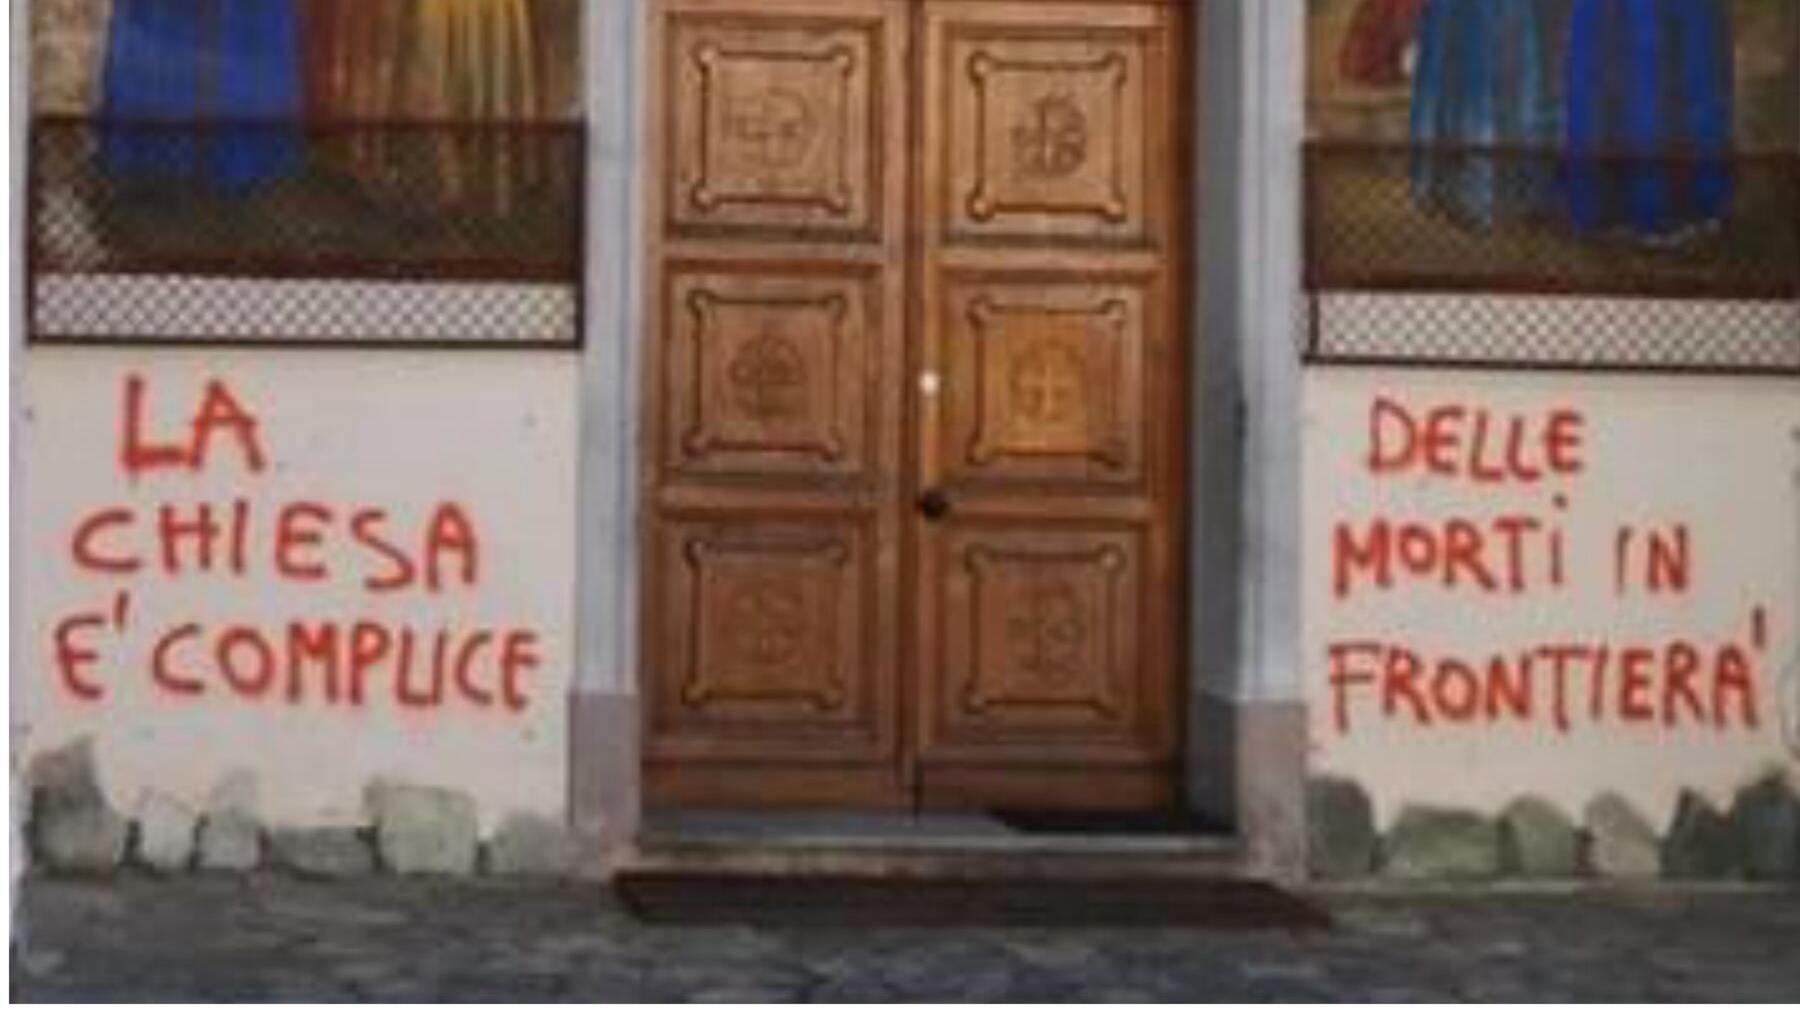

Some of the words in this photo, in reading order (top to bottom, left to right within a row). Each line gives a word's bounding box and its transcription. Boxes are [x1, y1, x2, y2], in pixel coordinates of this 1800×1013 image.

[118, 373, 265, 476] LA
[1366, 395, 1585, 484] DELLE
[70, 497, 479, 594] CHIESA
[1614, 522, 1692, 596] IN
